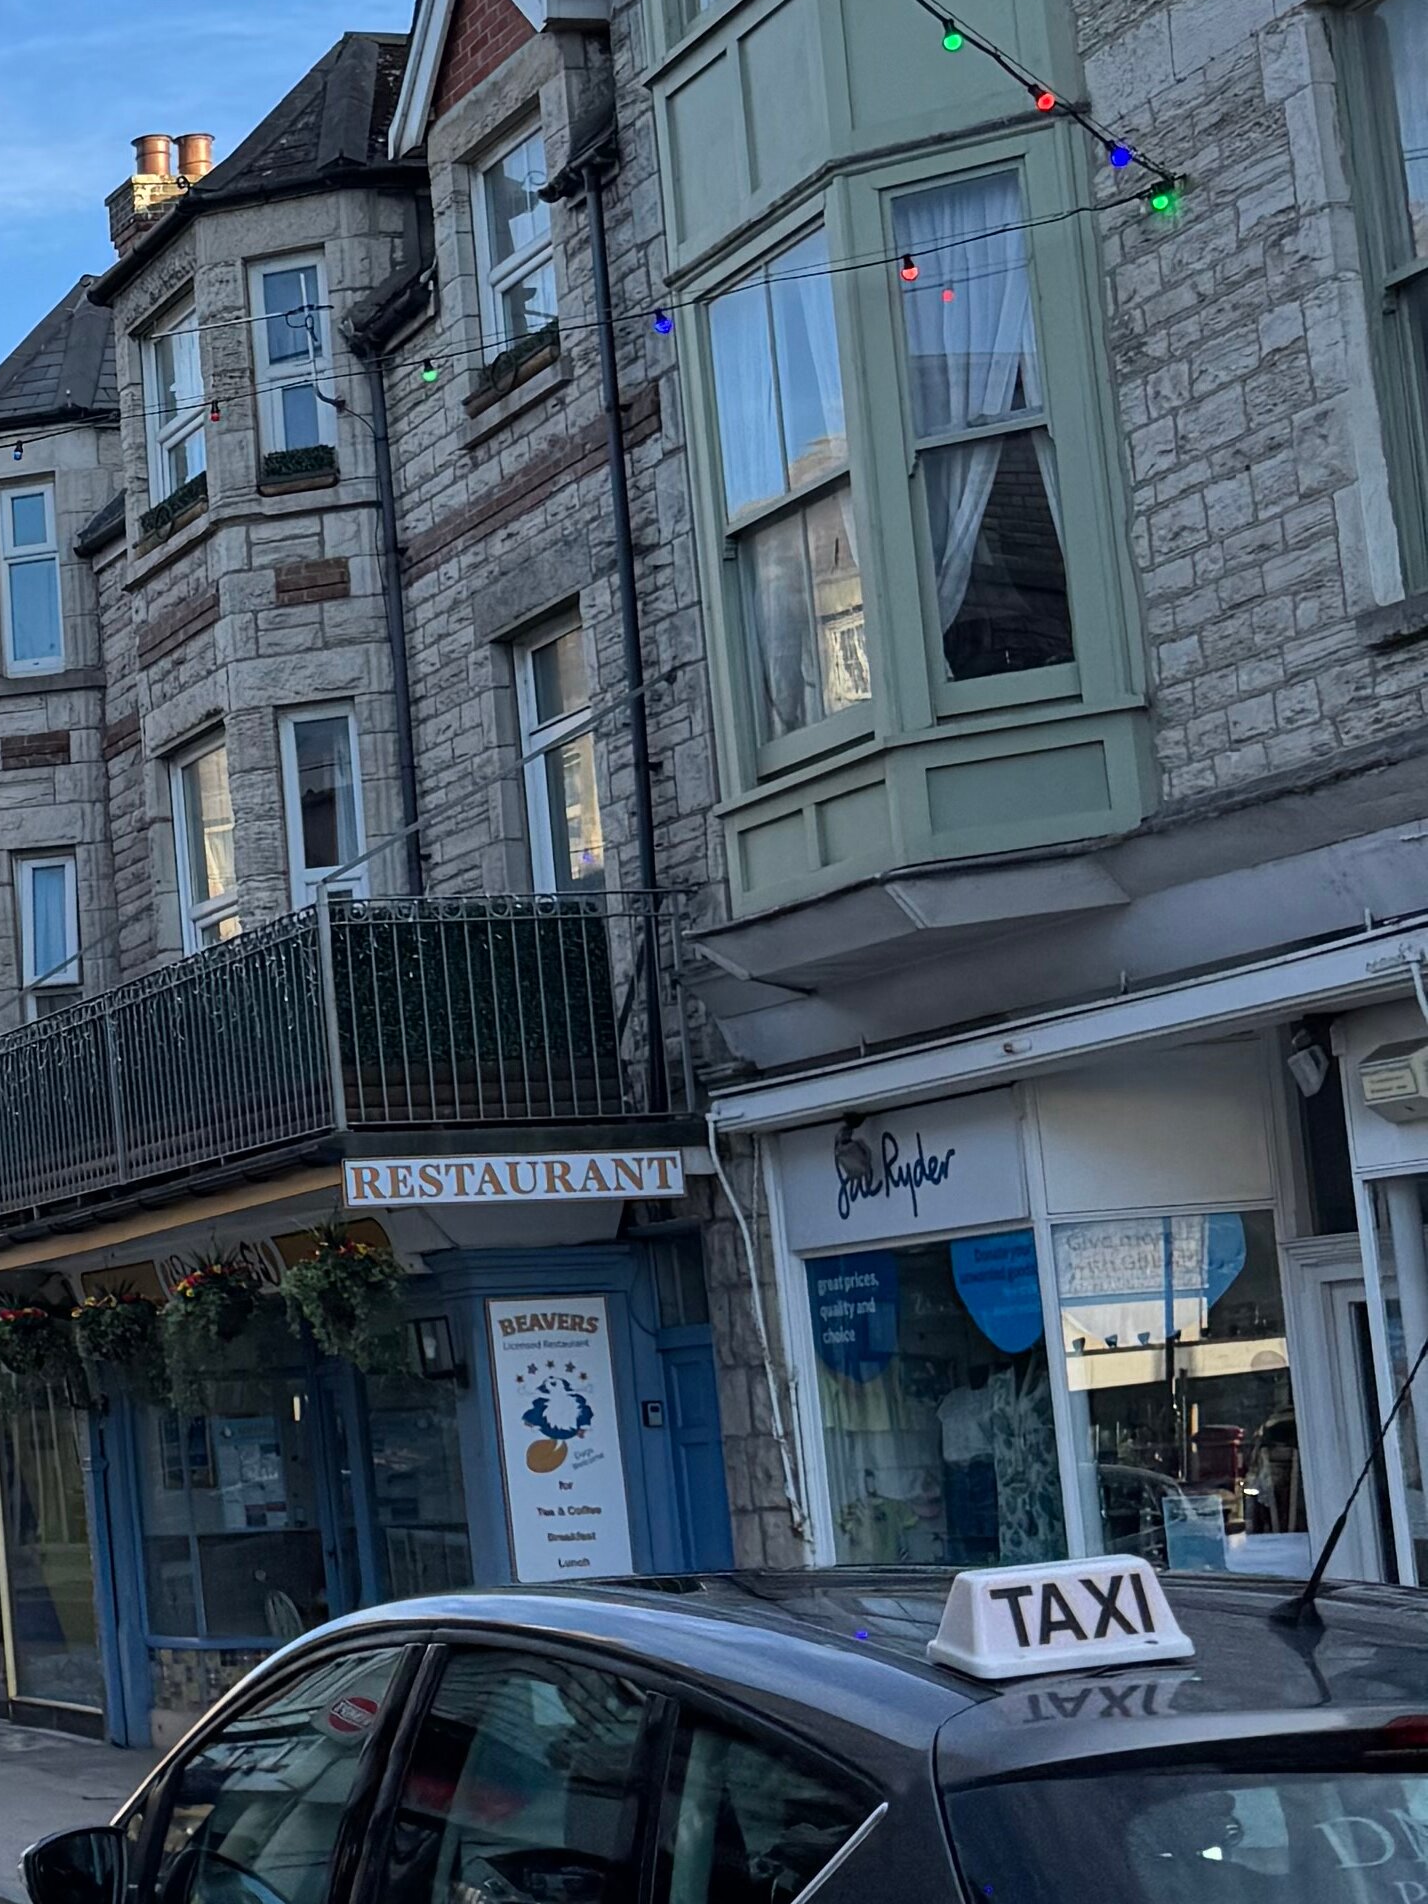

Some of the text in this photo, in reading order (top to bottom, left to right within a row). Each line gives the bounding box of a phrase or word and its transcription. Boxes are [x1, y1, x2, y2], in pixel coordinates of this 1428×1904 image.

[349, 1156, 678, 1201] RESTAURANT
[881, 1131, 955, 1218] Ryder
[817, 1270, 879, 1295] great prices,
[819, 1297, 876, 1320] quality and
[498, 1311, 600, 1337] BEAVERS
[822, 1327, 856, 1345] choice
[547, 1531, 596, 1542] Breakfast
[558, 1557, 590, 1568] Lunch
[989, 1573, 1156, 1647] TAXI
